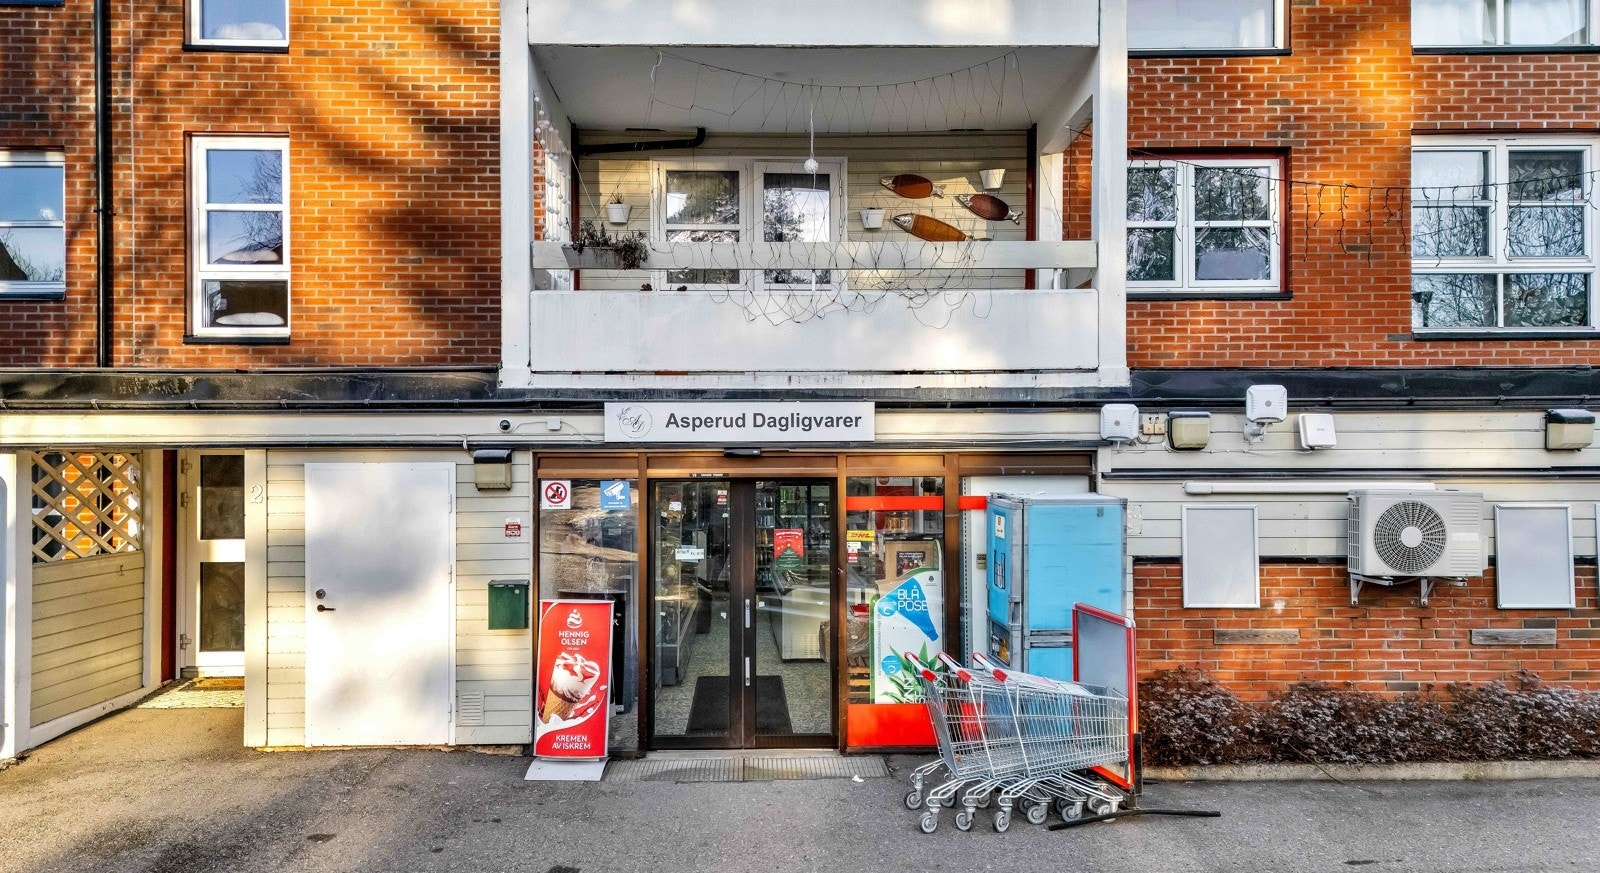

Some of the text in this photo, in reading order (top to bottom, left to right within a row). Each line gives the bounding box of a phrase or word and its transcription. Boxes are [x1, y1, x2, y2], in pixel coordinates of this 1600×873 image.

[666, 412, 862, 431] Asperud Dagligvarer
[249, 484, 264, 504] 2
[897, 584, 920, 600] BLÅ
[897, 600, 928, 612] POSE
